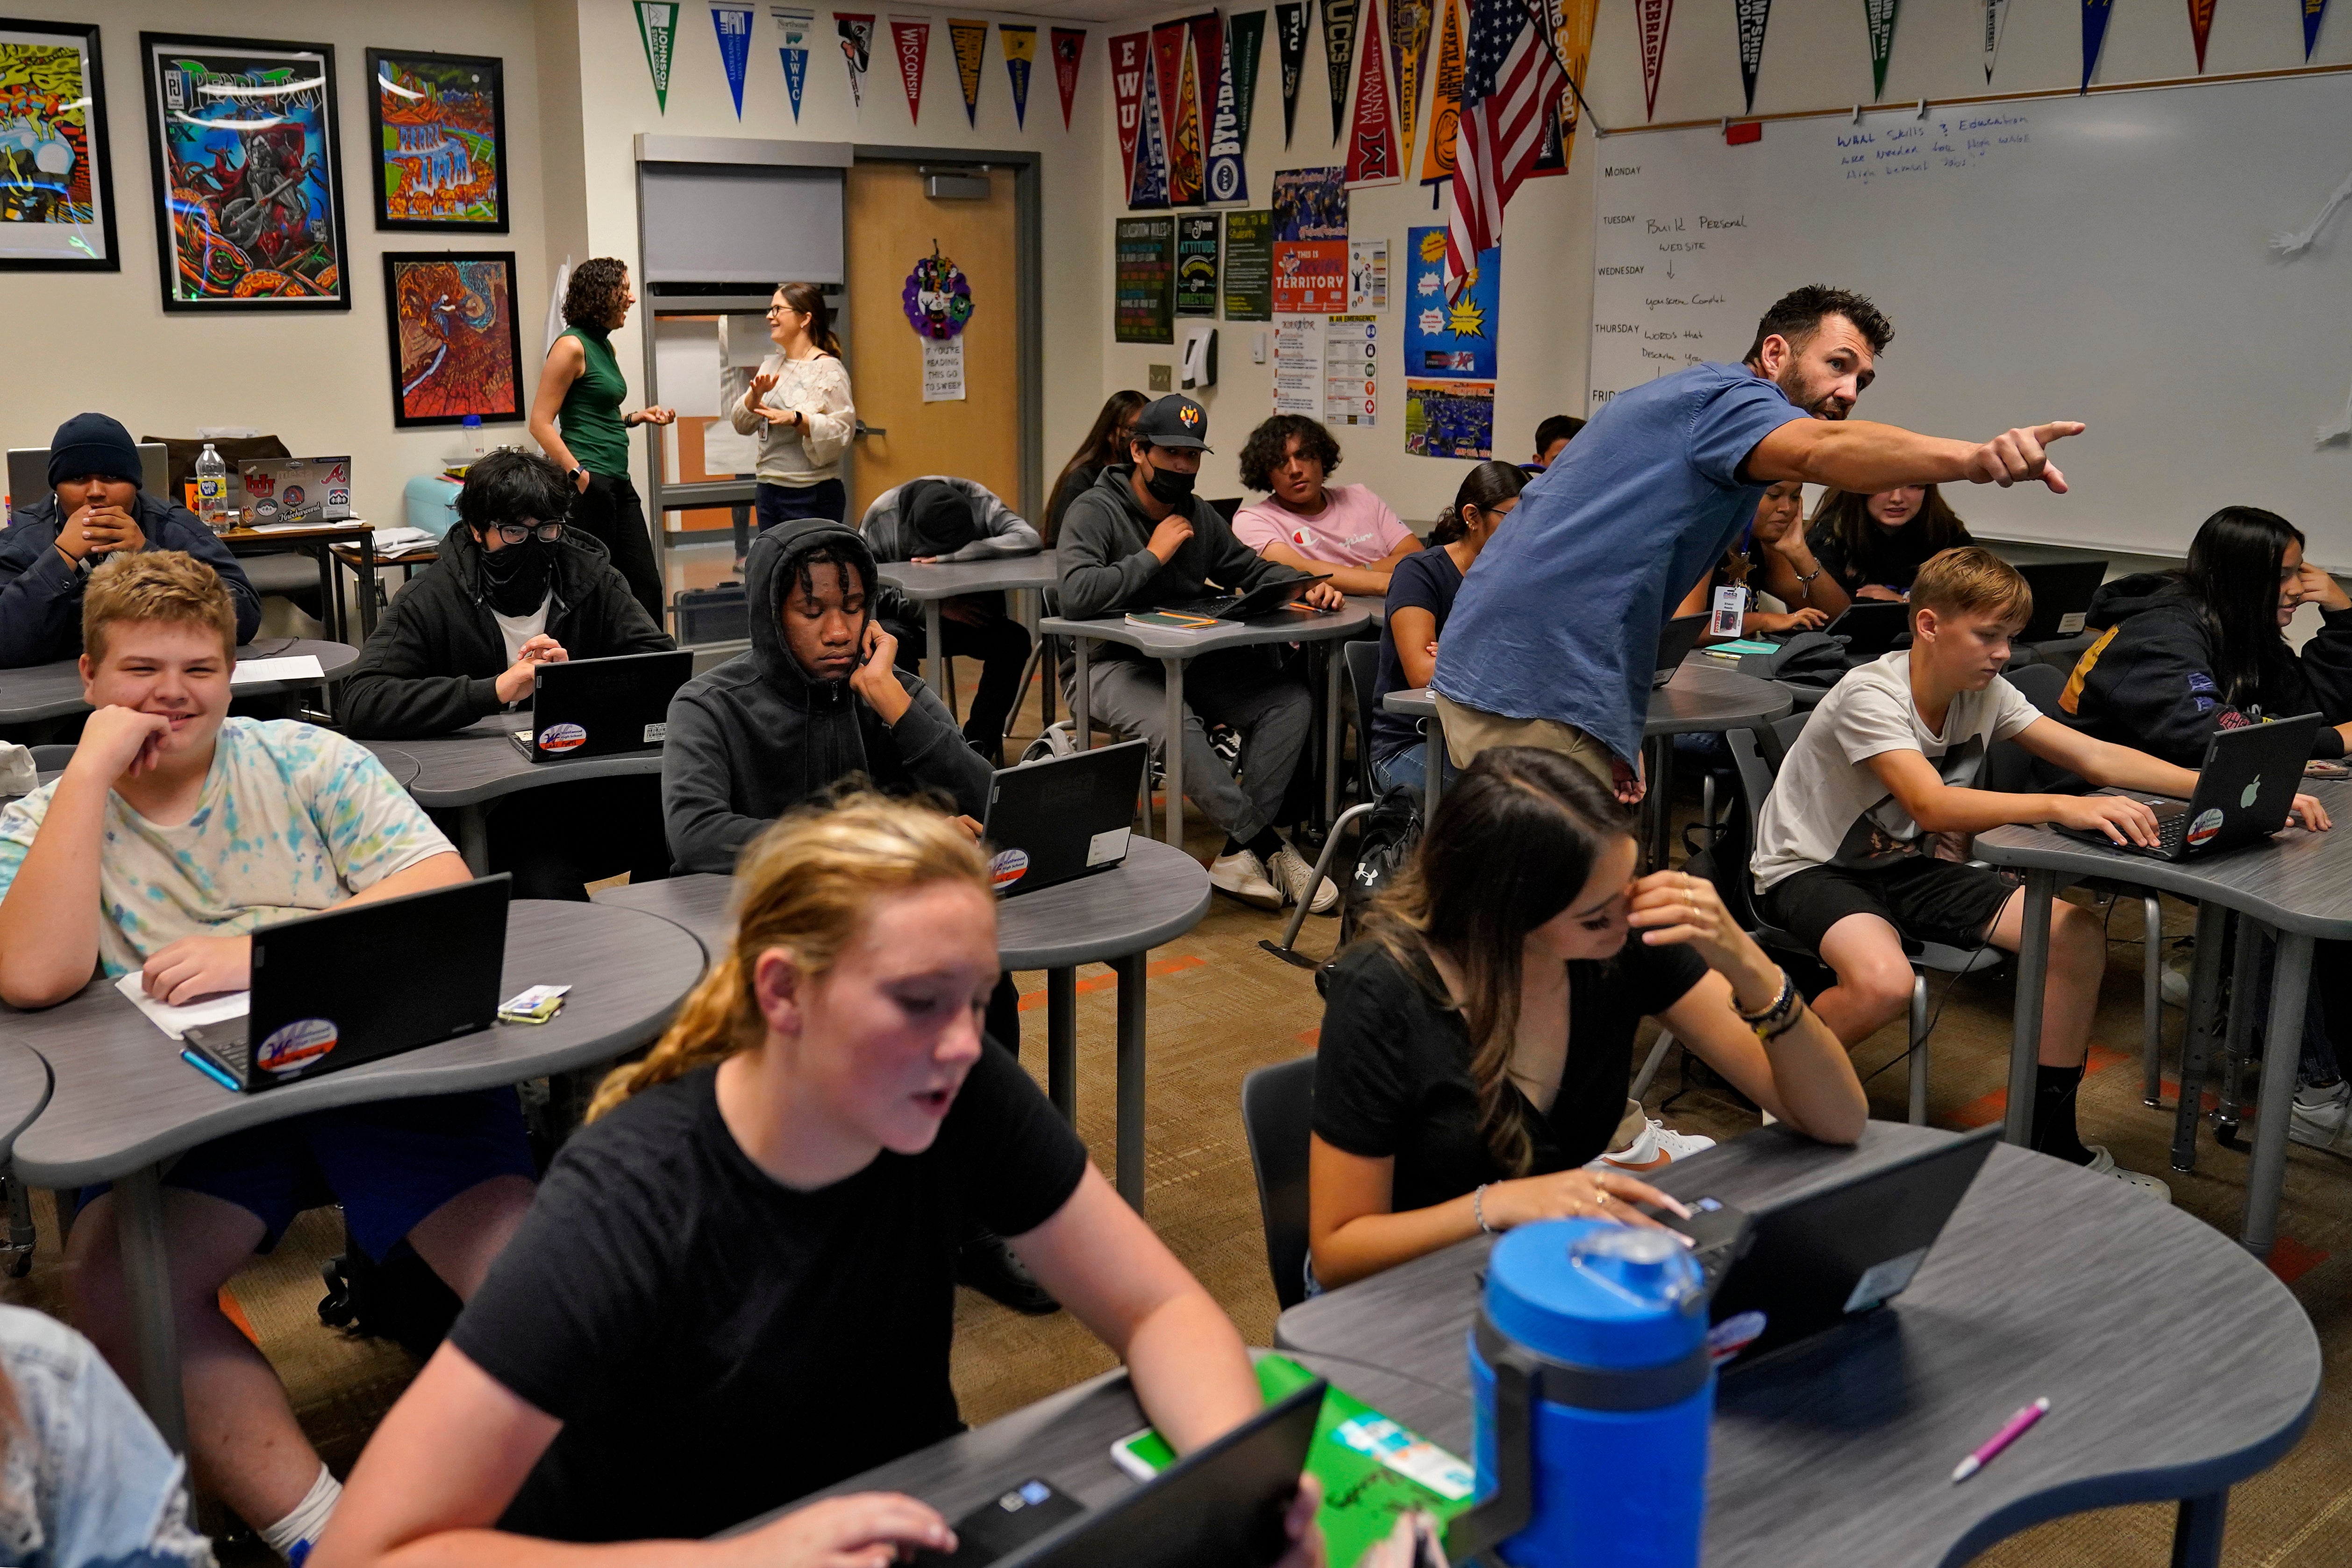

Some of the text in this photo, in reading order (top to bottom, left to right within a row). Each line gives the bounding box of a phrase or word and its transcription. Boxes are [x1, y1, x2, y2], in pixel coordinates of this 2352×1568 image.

[1290, 10, 1300, 51] BYU
[1326, 0, 1354, 64] UCCS
[1749, 0, 1767, 74] MPSHIRE
[658, 27, 669, 91] JOHNSON
[790, 50, 800, 100] NWTC
[901, 28, 919, 100] WISCONSIN
[1371, 36, 1385, 124] UNIVERSITY
[1117, 41, 1139, 129] EWU
[1359, 71, 1376, 125] MIAMI
[1403, 62, 1414, 133] TIGERS
[1447, 64, 1462, 104] NORTH
[1605, 166, 1641, 178] MONDAY
[1604, 215, 1635, 225] TUESDAY
[1297, 249, 1319, 259] THIS IS
[1598, 266, 1645, 276] WEDNESDAY
[1276, 276, 1344, 289] TERRITORY
[1595, 324, 1639, 333] THURSDAY
[1592, 390, 1619, 402] FRID
